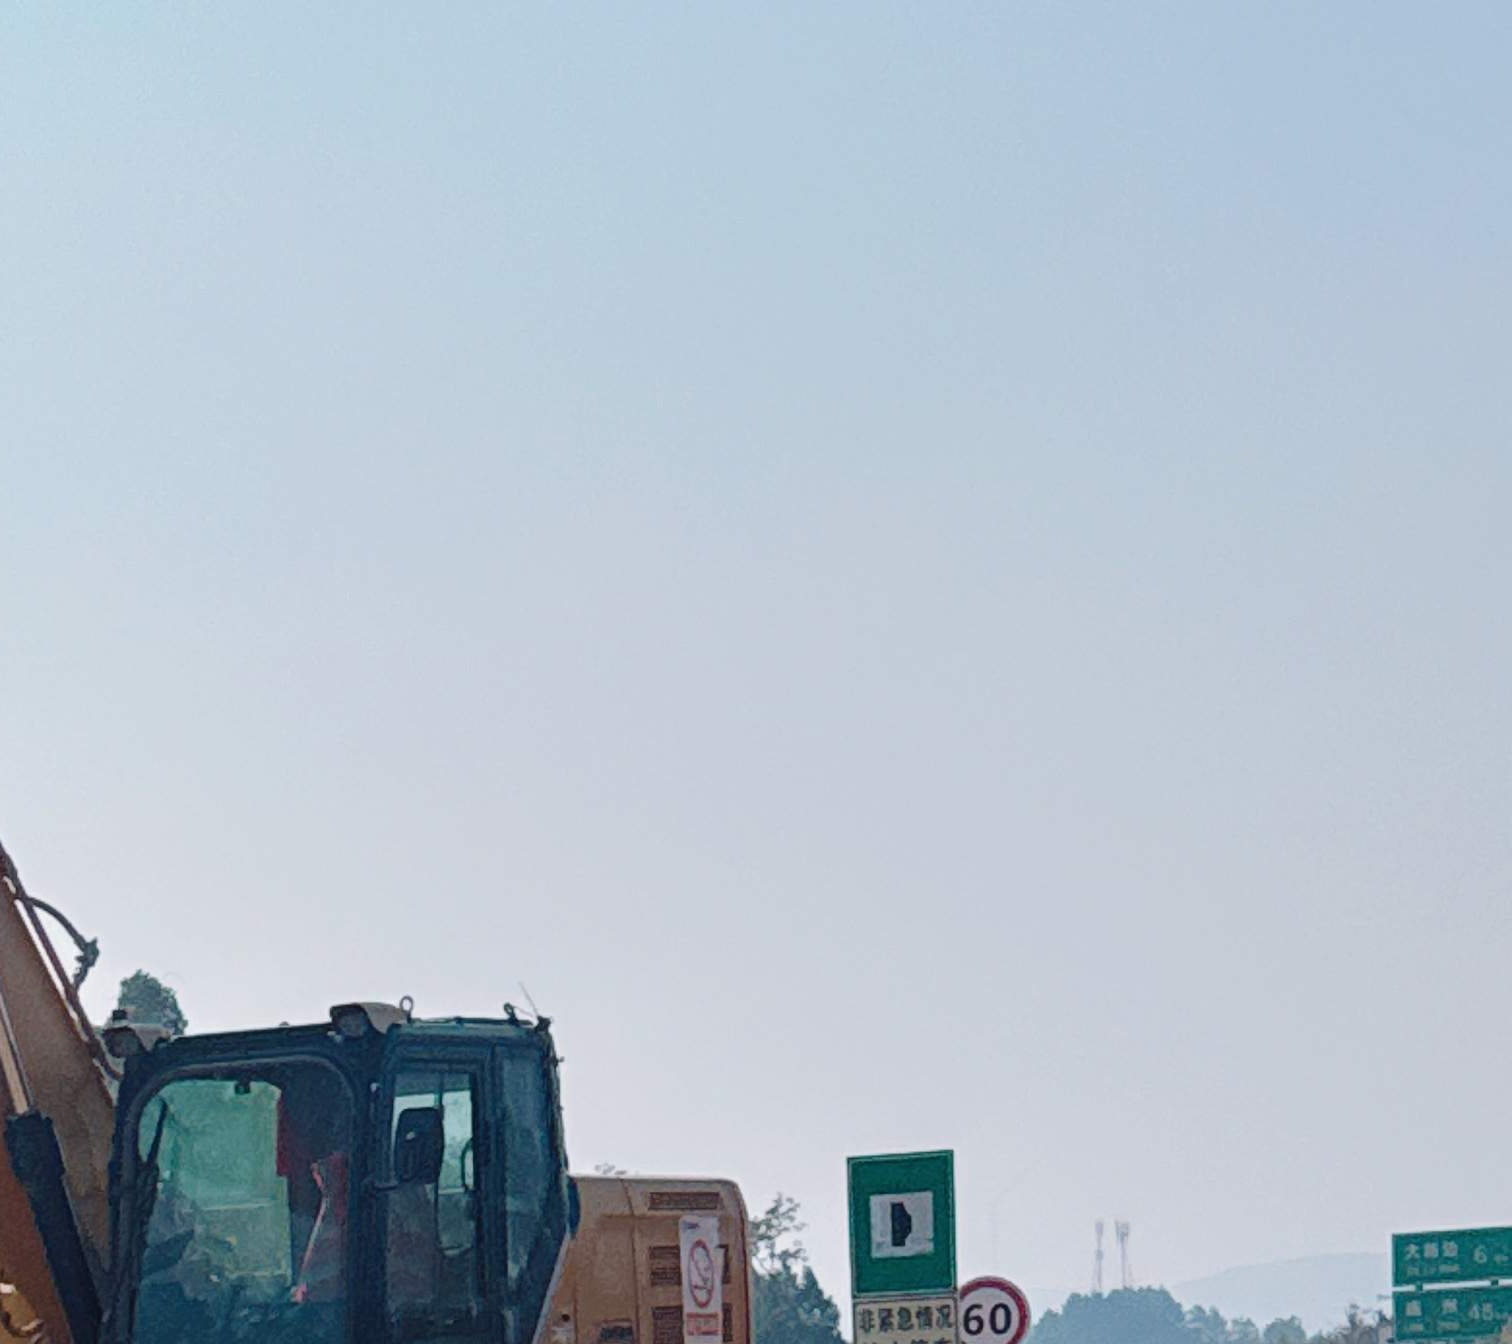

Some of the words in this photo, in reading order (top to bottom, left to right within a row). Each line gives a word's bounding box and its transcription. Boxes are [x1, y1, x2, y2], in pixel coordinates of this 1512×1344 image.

[859, 1304, 953, 1333] 非紧急情况
[963, 1302, 1012, 1336] 60
